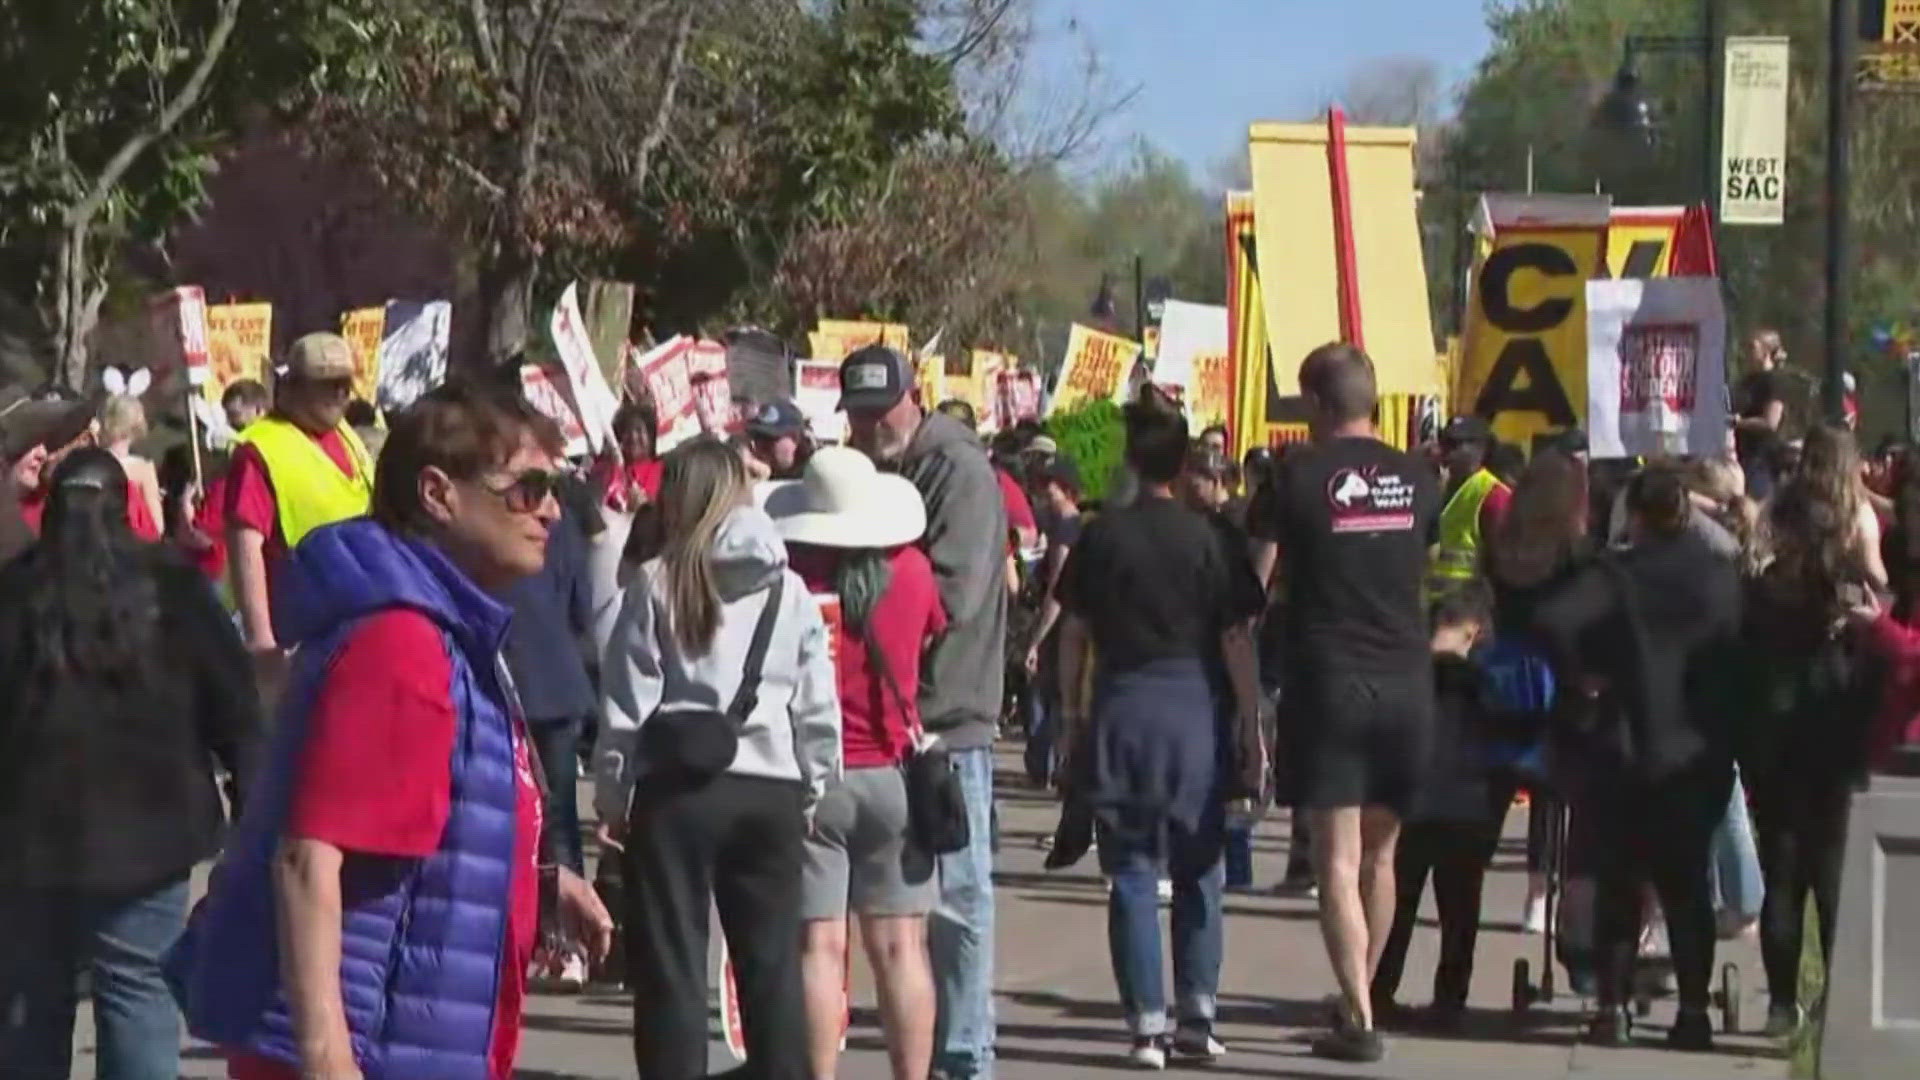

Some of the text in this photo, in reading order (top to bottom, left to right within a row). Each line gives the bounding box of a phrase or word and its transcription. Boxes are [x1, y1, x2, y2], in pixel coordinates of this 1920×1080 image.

[1727, 157, 1779, 175] WEST
[1727, 176, 1780, 201] SAC
[1377, 475, 1401, 486] WE
[1371, 485, 1415, 496] CAN'T
[1374, 497, 1413, 508] WAIT
